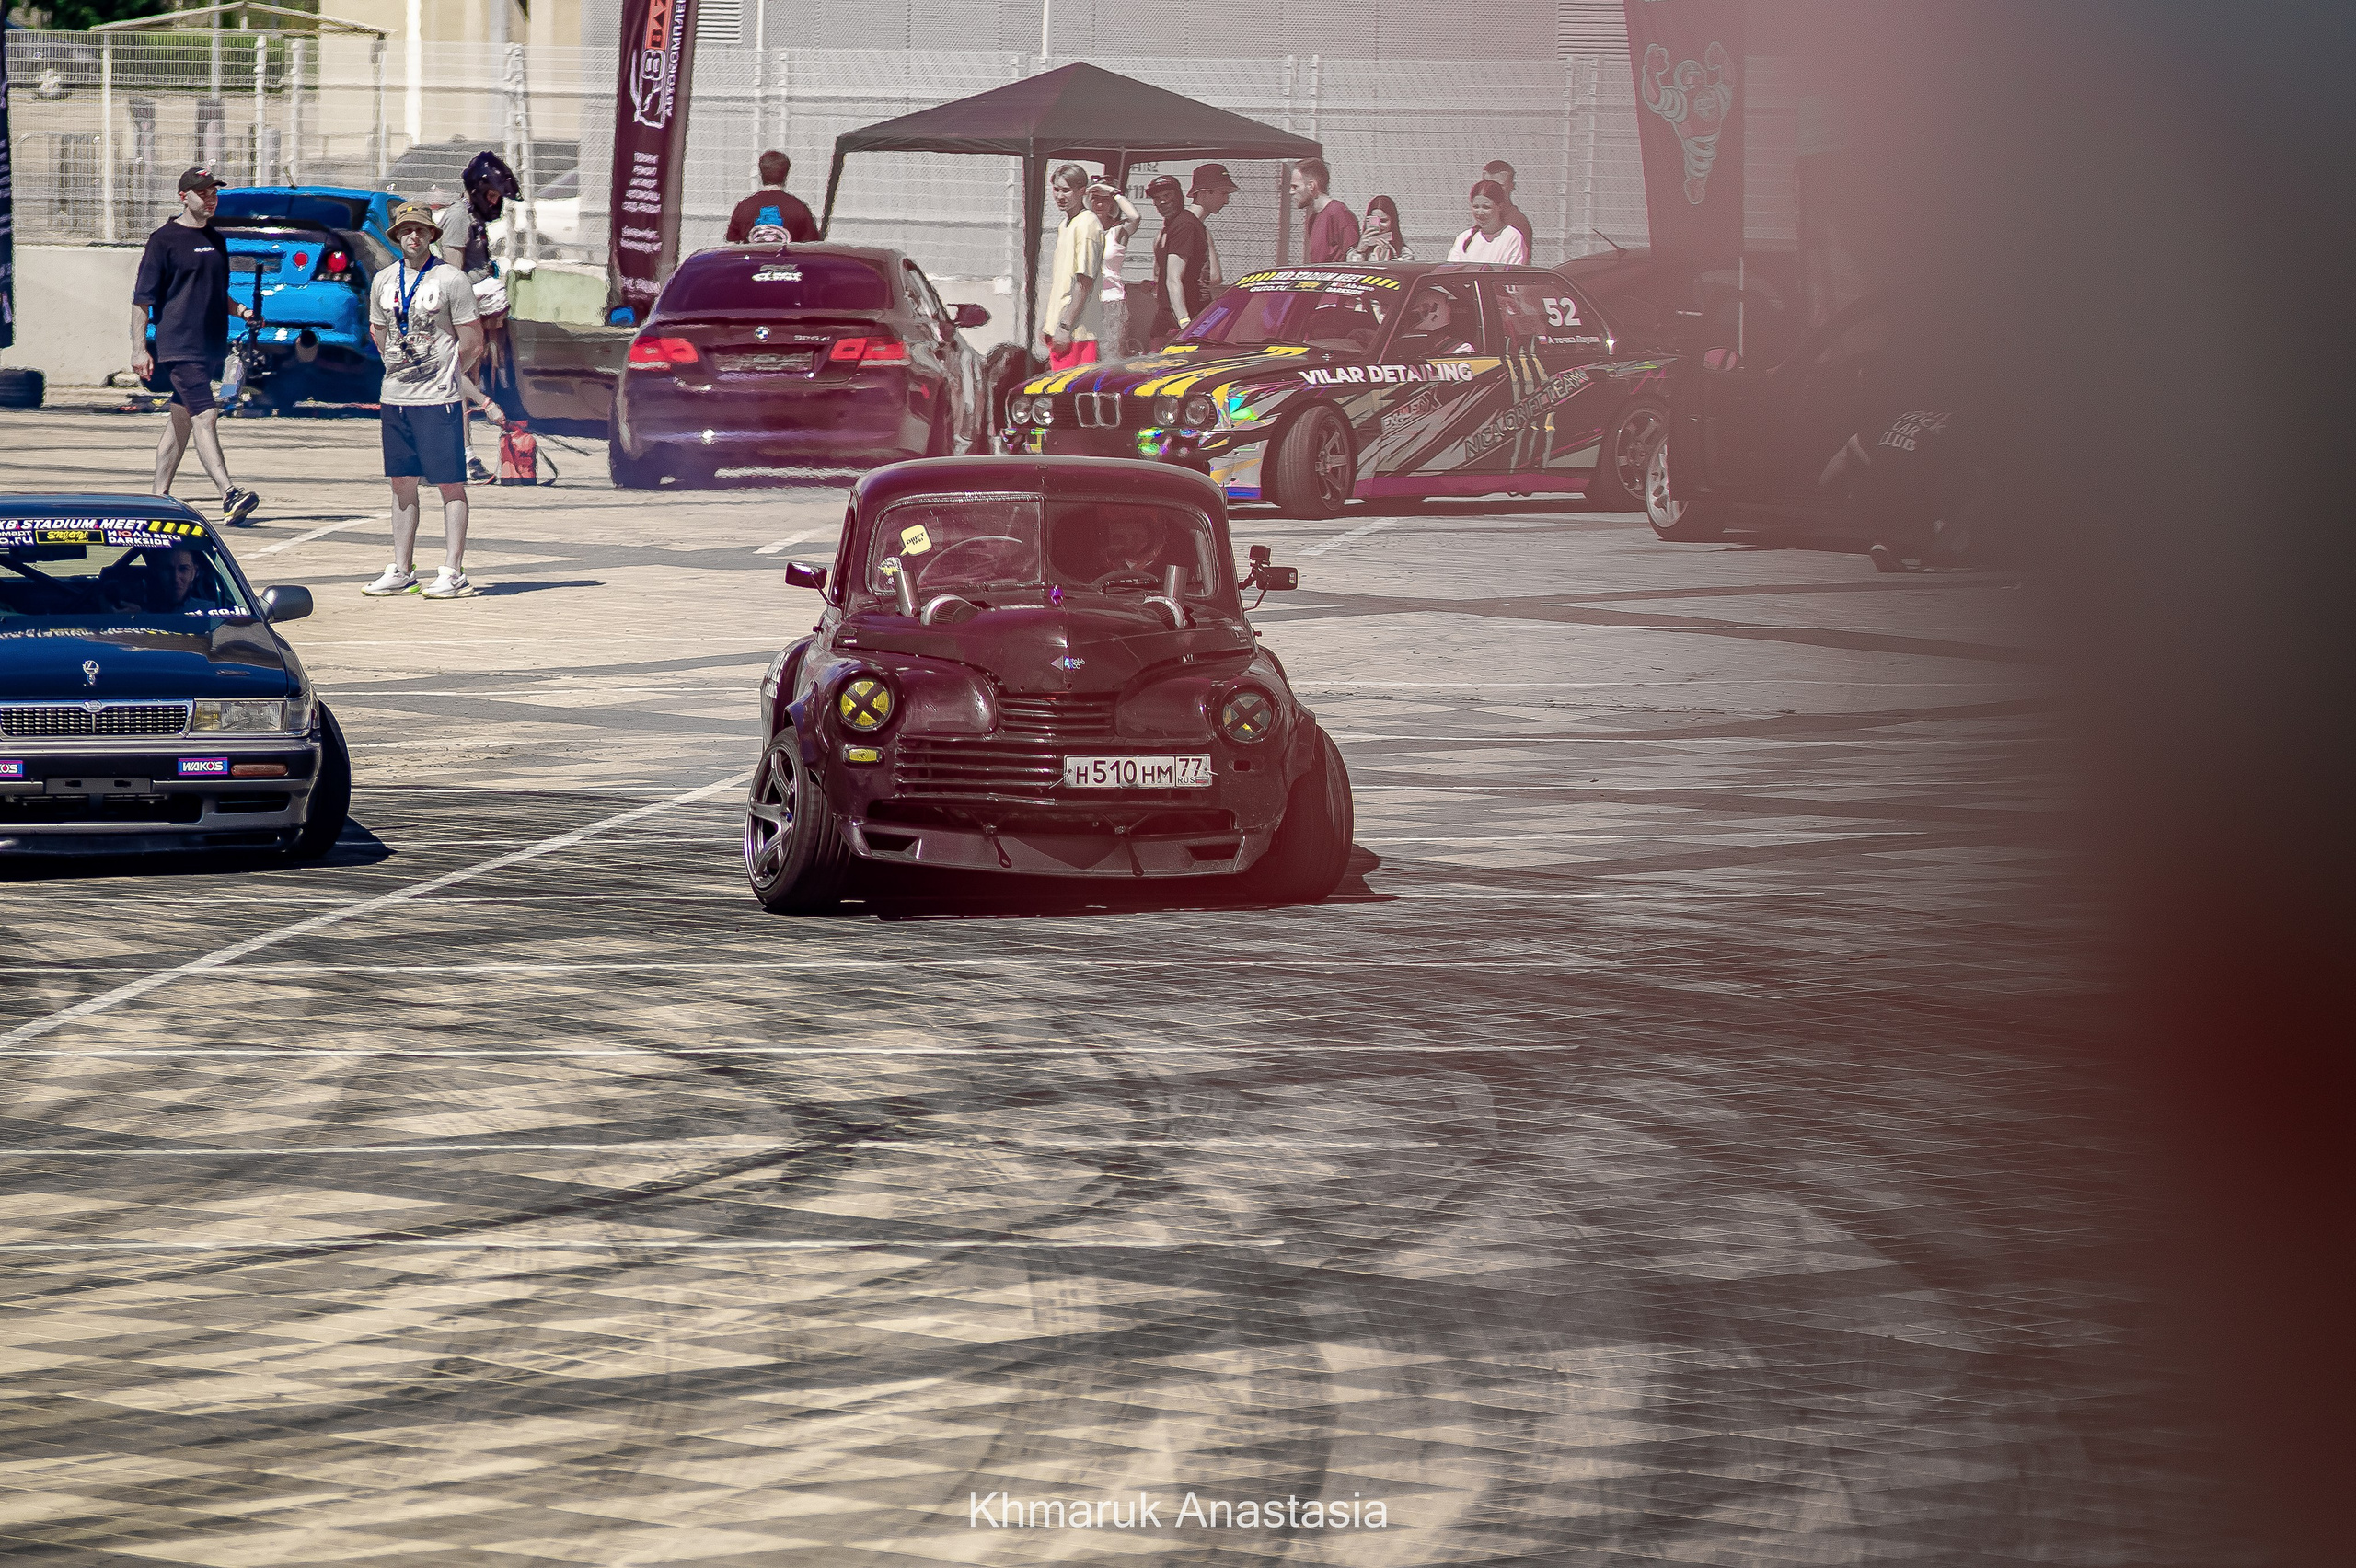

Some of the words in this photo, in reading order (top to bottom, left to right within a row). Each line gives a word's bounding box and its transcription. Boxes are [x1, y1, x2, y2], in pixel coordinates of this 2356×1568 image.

[1542, 297, 1581, 327] 52
[1298, 365, 1365, 385] VILAR
[1366, 363, 1473, 383] DETAILING
[1543, 367, 1590, 403] TEAM
[1892, 420, 1922, 437] CAR
[1878, 432, 1917, 452] CLUB
[21, 518, 96, 530] STADIUM
[98, 518, 147, 530] MEET
[108, 537, 172, 548] DARKSIDE
[1178, 757, 1203, 778] 77
